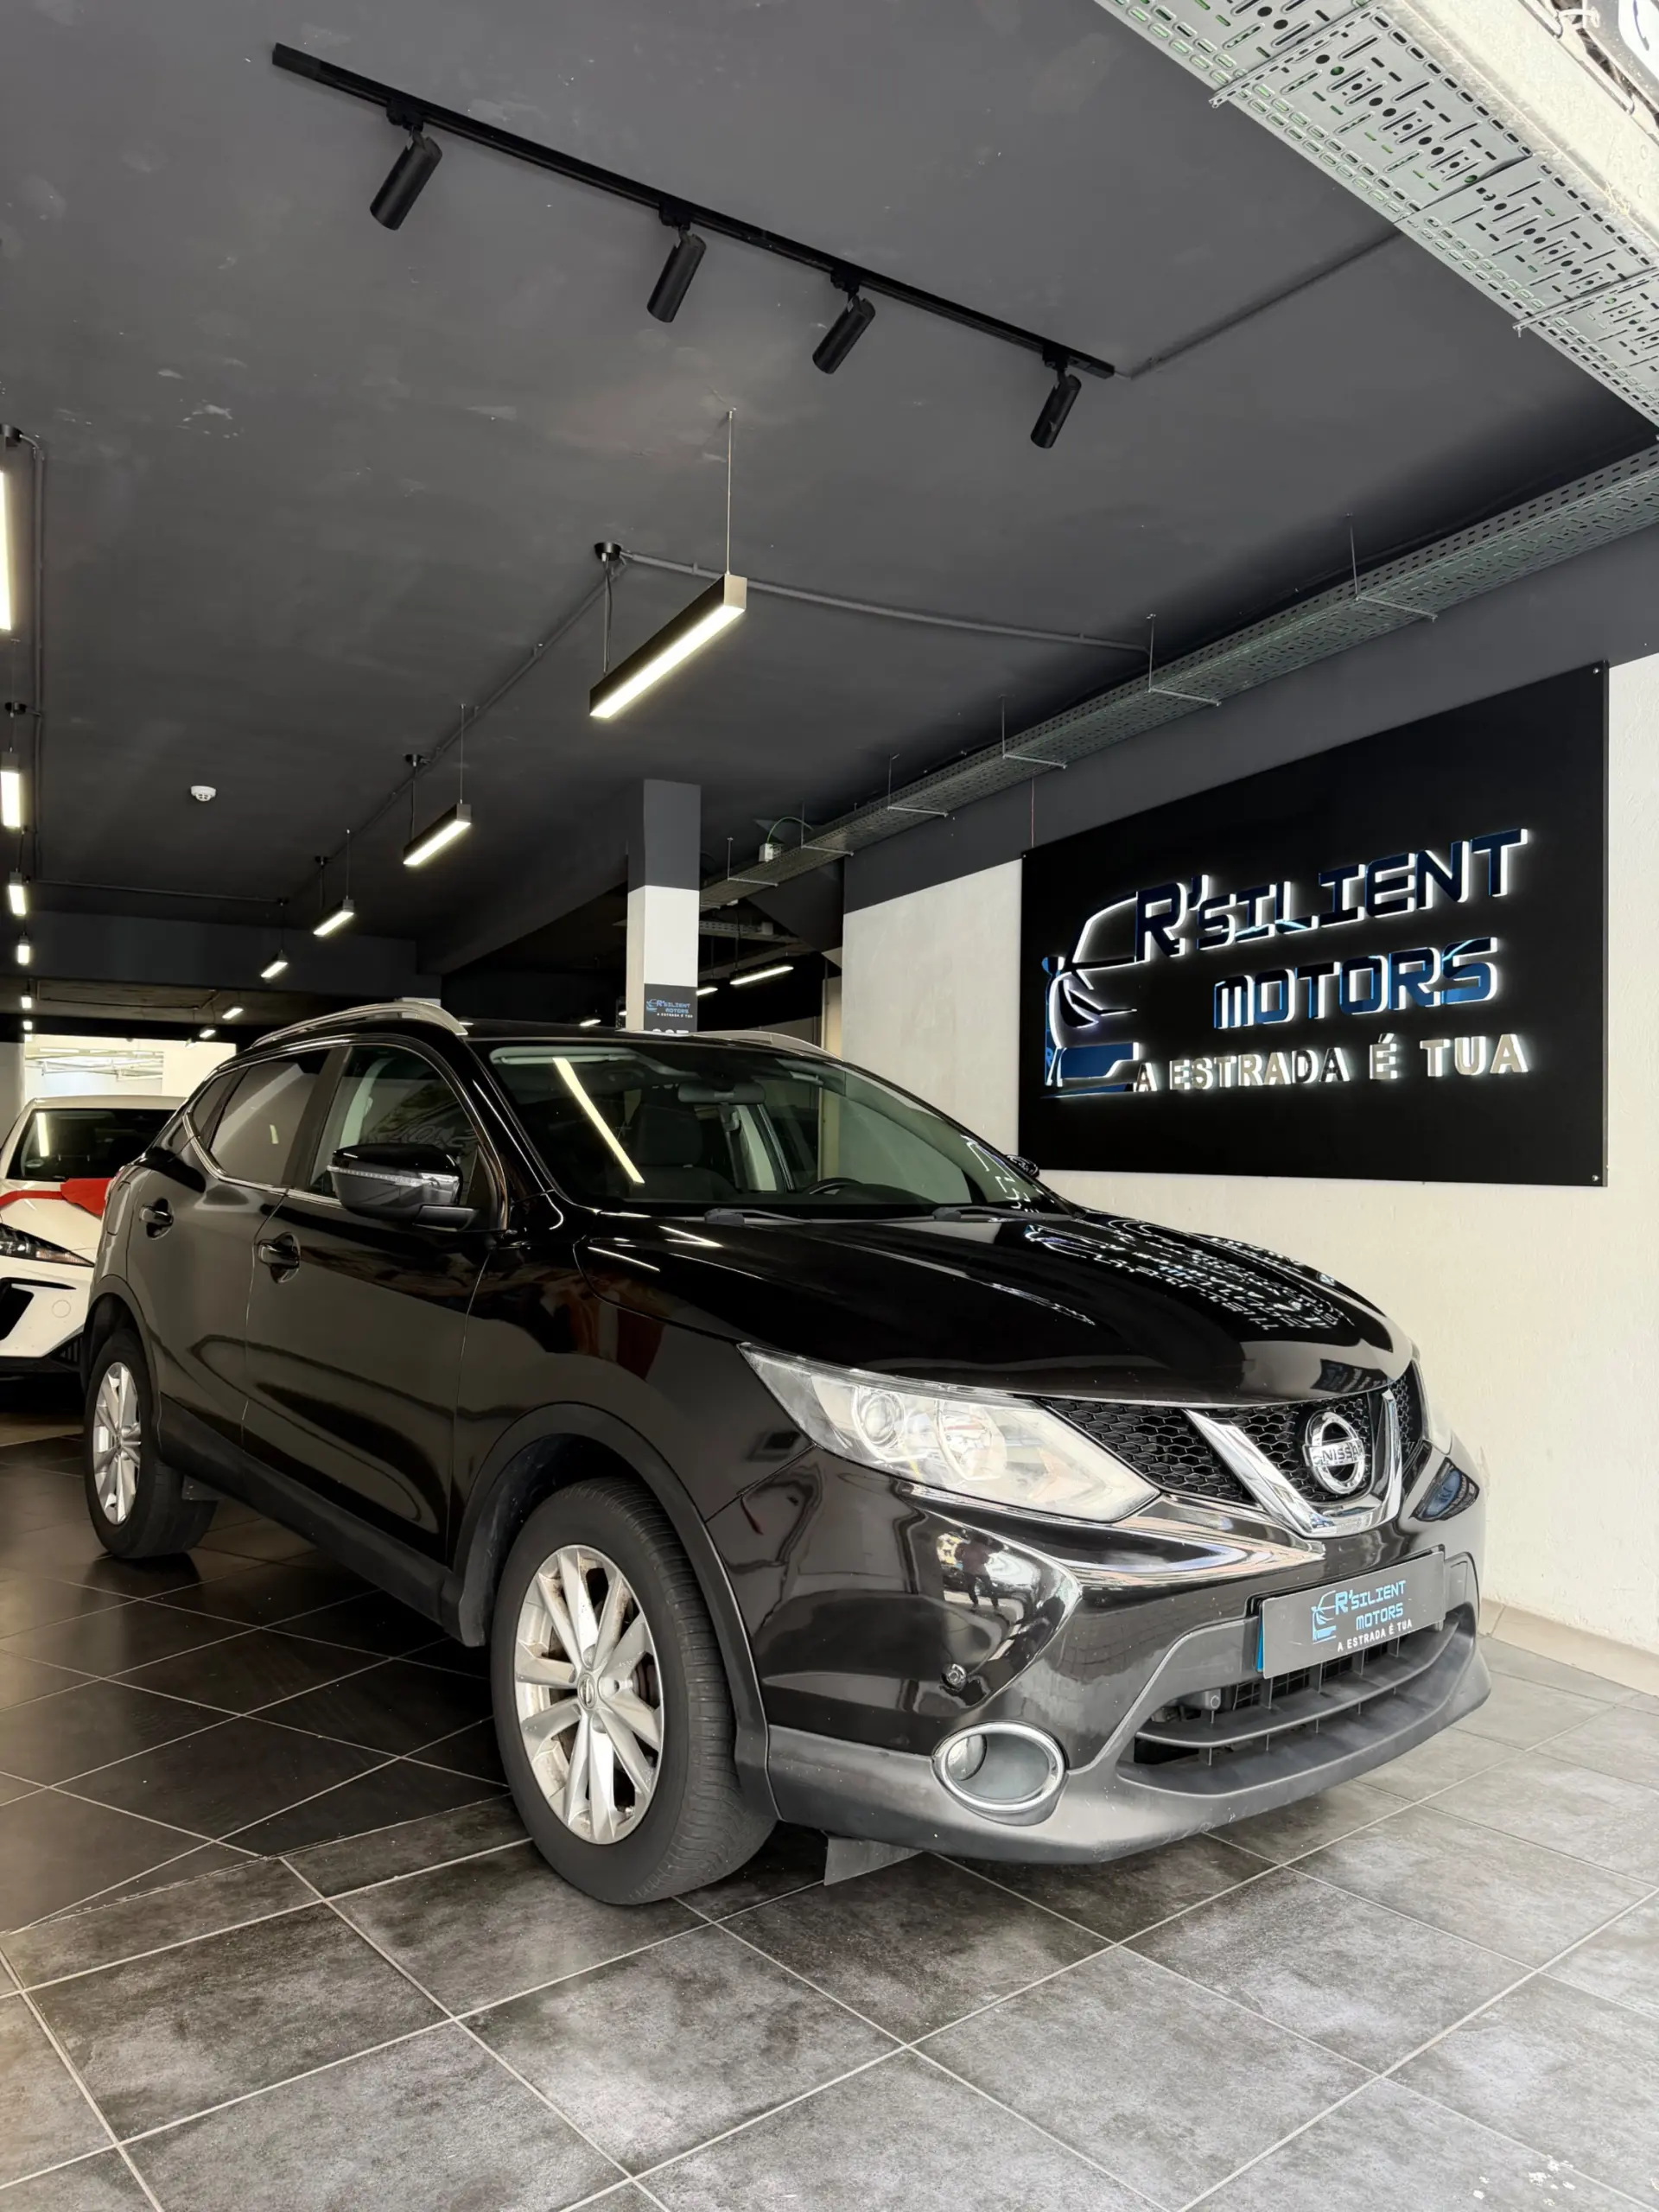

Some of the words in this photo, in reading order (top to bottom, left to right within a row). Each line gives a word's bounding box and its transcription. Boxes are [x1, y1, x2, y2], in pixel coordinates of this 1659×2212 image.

[1135, 828, 1528, 964] R'SILIENT
[1214, 937, 1498, 1029] MOTORS
[1135, 1062, 1158, 1092] A
[1169, 1047, 1350, 1090] ESTRADA
[1370, 1033, 1397, 1080] É
[1420, 1034, 1529, 1077] TUA
[1335, 1580, 1406, 1615] R'SILIENT
[1356, 1603, 1403, 1630] MOTORS
[1338, 1642, 1344, 1652] A
[1347, 1628, 1386, 1649] ESTRADA
[1397, 1618, 1412, 1631] TUA
